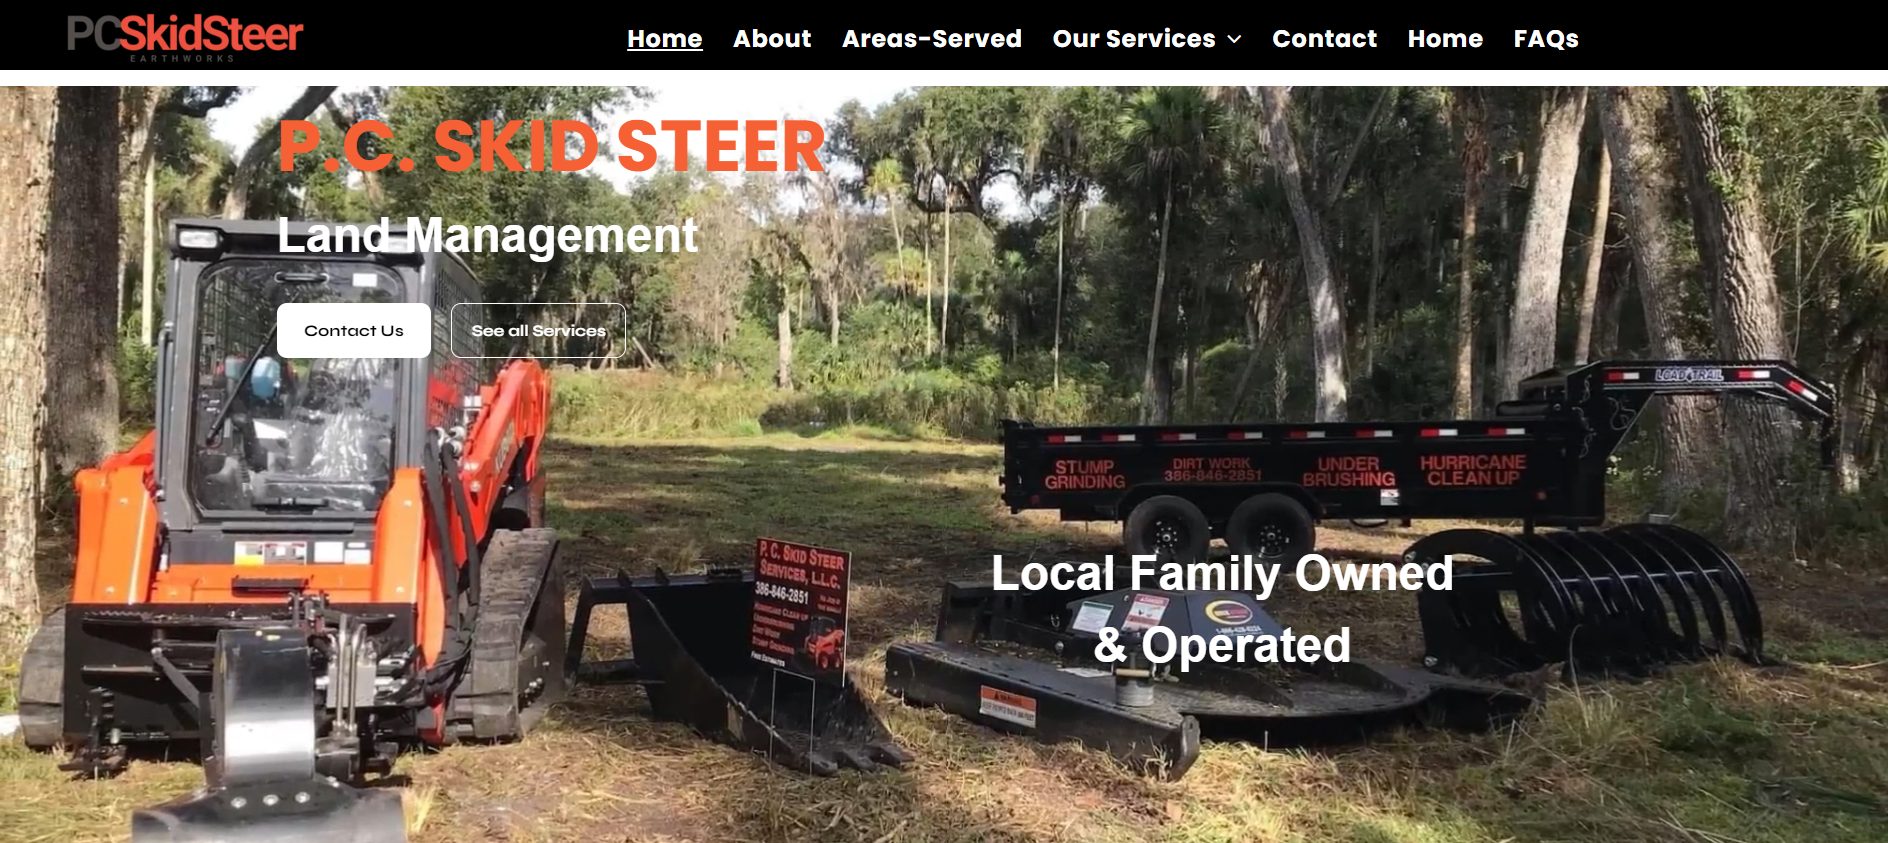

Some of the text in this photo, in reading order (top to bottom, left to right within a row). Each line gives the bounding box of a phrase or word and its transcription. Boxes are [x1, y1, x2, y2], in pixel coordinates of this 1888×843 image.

[1655, 368, 1725, 382] LOAD TRAIL
[1055, 459, 1115, 475] STUMP
[1172, 456, 1252, 470] DIRT WORK
[1317, 456, 1380, 471] UNDER
[1420, 454, 1528, 471] HURRICANE
[1044, 474, 1126, 491] GRINDING
[1163, 469, 1262, 482] 386-846-2851
[1302, 471, 1396, 487] BRUSHING
[1426, 470, 1521, 486] CLEAN UP
[754, 581, 809, 605] 386-846-2851
